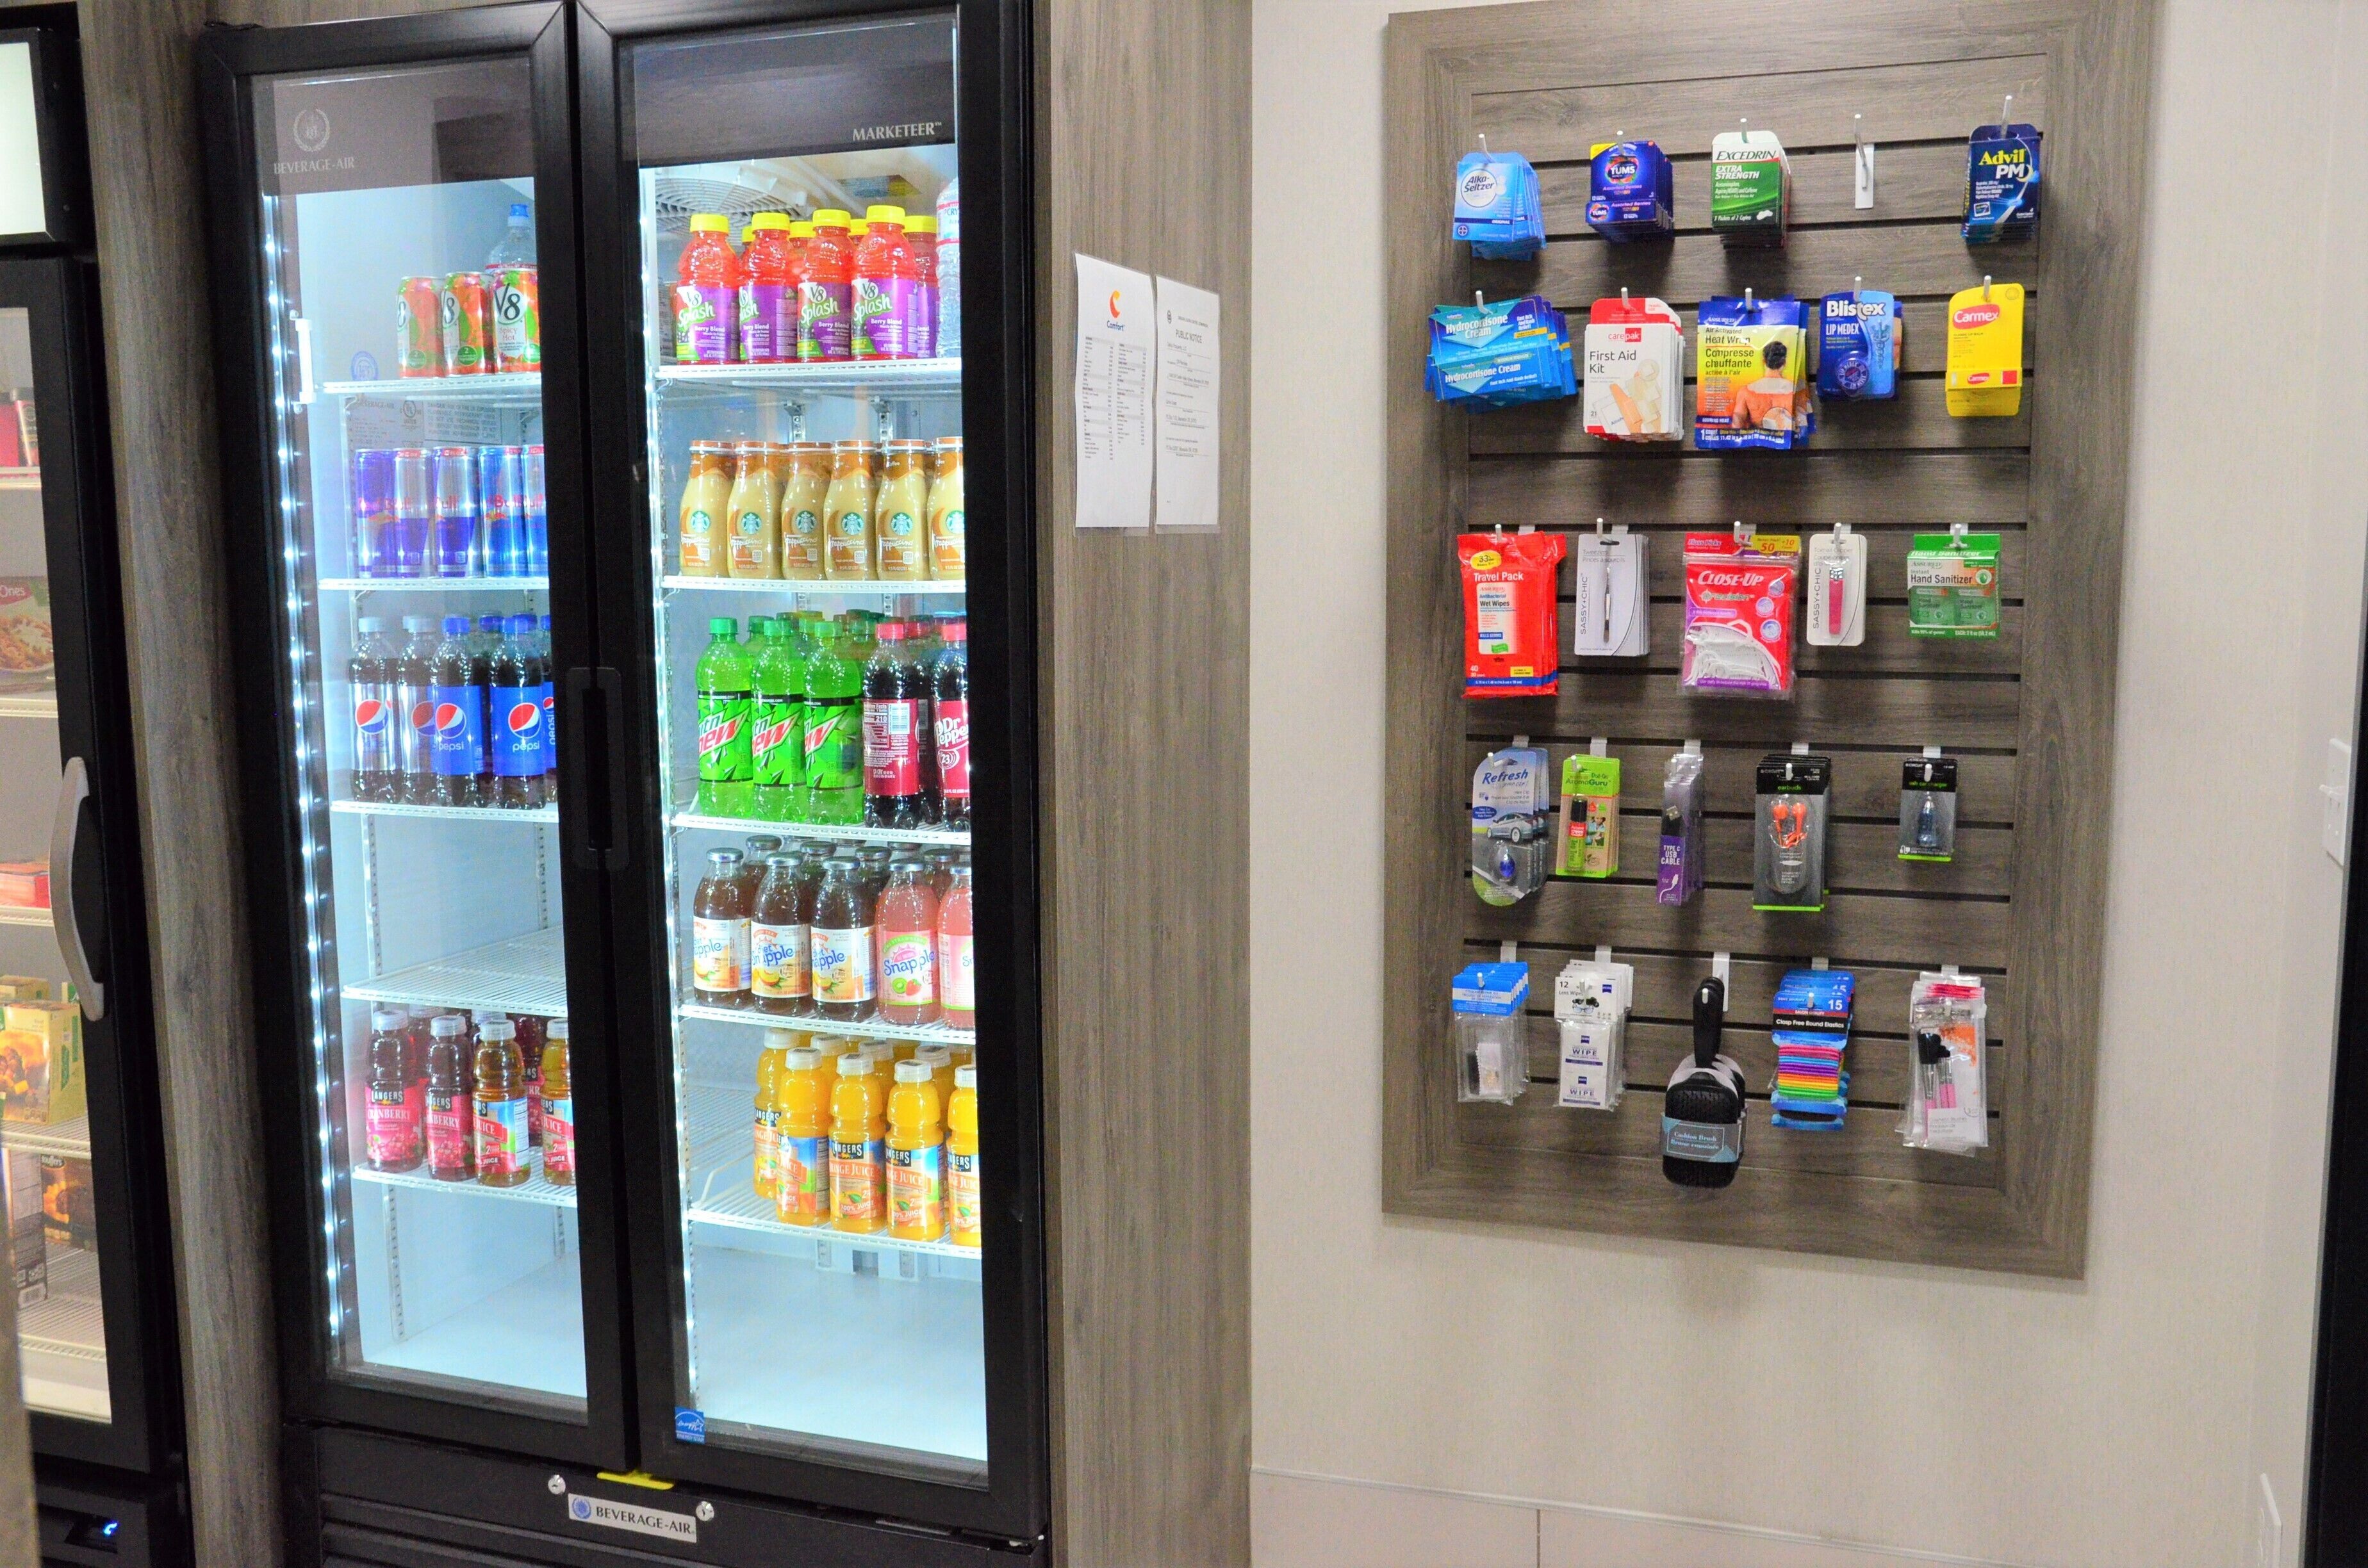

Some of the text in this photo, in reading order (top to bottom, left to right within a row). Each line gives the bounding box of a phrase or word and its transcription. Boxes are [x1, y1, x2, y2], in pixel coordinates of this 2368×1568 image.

[1716, 150, 1777, 161] EXCEDRIN
[1978, 149, 2025, 166] Advil
[274, 156, 355, 174] BEVERAGE-AIR
[1611, 166, 1635, 175] TUMS
[1996, 163, 2025, 179] PM
[1467, 176, 1490, 184] Alka-
[1715, 171, 1760, 180] STRENGTH
[1464, 182, 1494, 193] Seltzer
[810, 284, 824, 302] V8
[862, 281, 876, 299] V8
[495, 282, 520, 321] V8
[801, 297, 840, 324] Splash
[853, 293, 892, 323] Splash
[1826, 300, 1886, 321] Blistex
[1953, 311, 1999, 323] Carmex
[1106, 320, 1124, 332] Comfort
[1445, 315, 1508, 334] Hydrocortisone
[1826, 323, 1860, 336] LIP MEDEX
[500, 327, 518, 335] Spicy
[1175, 329, 1203, 344] PUBLIC NOTICE
[1465, 327, 1492, 339] Cream
[1706, 335, 1750, 345] Heat Wrp
[1590, 350, 1637, 361] First Aid
[1706, 348, 1754, 358] Compresse
[1590, 363, 1605, 373] Kit
[1706, 359, 1752, 368] chauffante
[1445, 363, 1521, 384] Hydrocortisone Cream
[1968, 375, 1989, 383] Carmex
[1762, 543, 1775, 551] 50
[1474, 571, 1524, 582] Travel Pack
[1911, 574, 1973, 584] Hand Sanitizer
[1813, 568, 1821, 629] SASSY+CHIC
[942, 717, 961, 733] Dr
[438, 741, 465, 752] pepsi
[512, 741, 541, 753] pepsi
[941, 753, 950, 764] 23
[1482, 768, 1529, 785] Refresh
[1566, 778, 1608, 787] AromaGuru
[1661, 857, 1680, 865] CABLE
[695, 939, 723, 959] apple
[752, 944, 794, 967] Snpple
[884, 949, 935, 977] Snapple
[1828, 999, 1843, 1011] 15
[1572, 1048, 1597, 1056] WIPE
[371, 1090, 404, 1103] LANGERS
[1570, 1088, 1595, 1097] WIPE
[429, 1115, 460, 1129] NBERRY
[1674, 1131, 1697, 1140] Cushion
[486, 1145, 491, 1154] 2
[552, 1143, 558, 1152] 2
[850, 1163, 875, 1177] JUICE
[899, 1172, 924, 1185] JUICE
[840, 1201, 874, 1211] 100% JUICE
[596, 1506, 692, 1535] BEVERAGE-AIR
